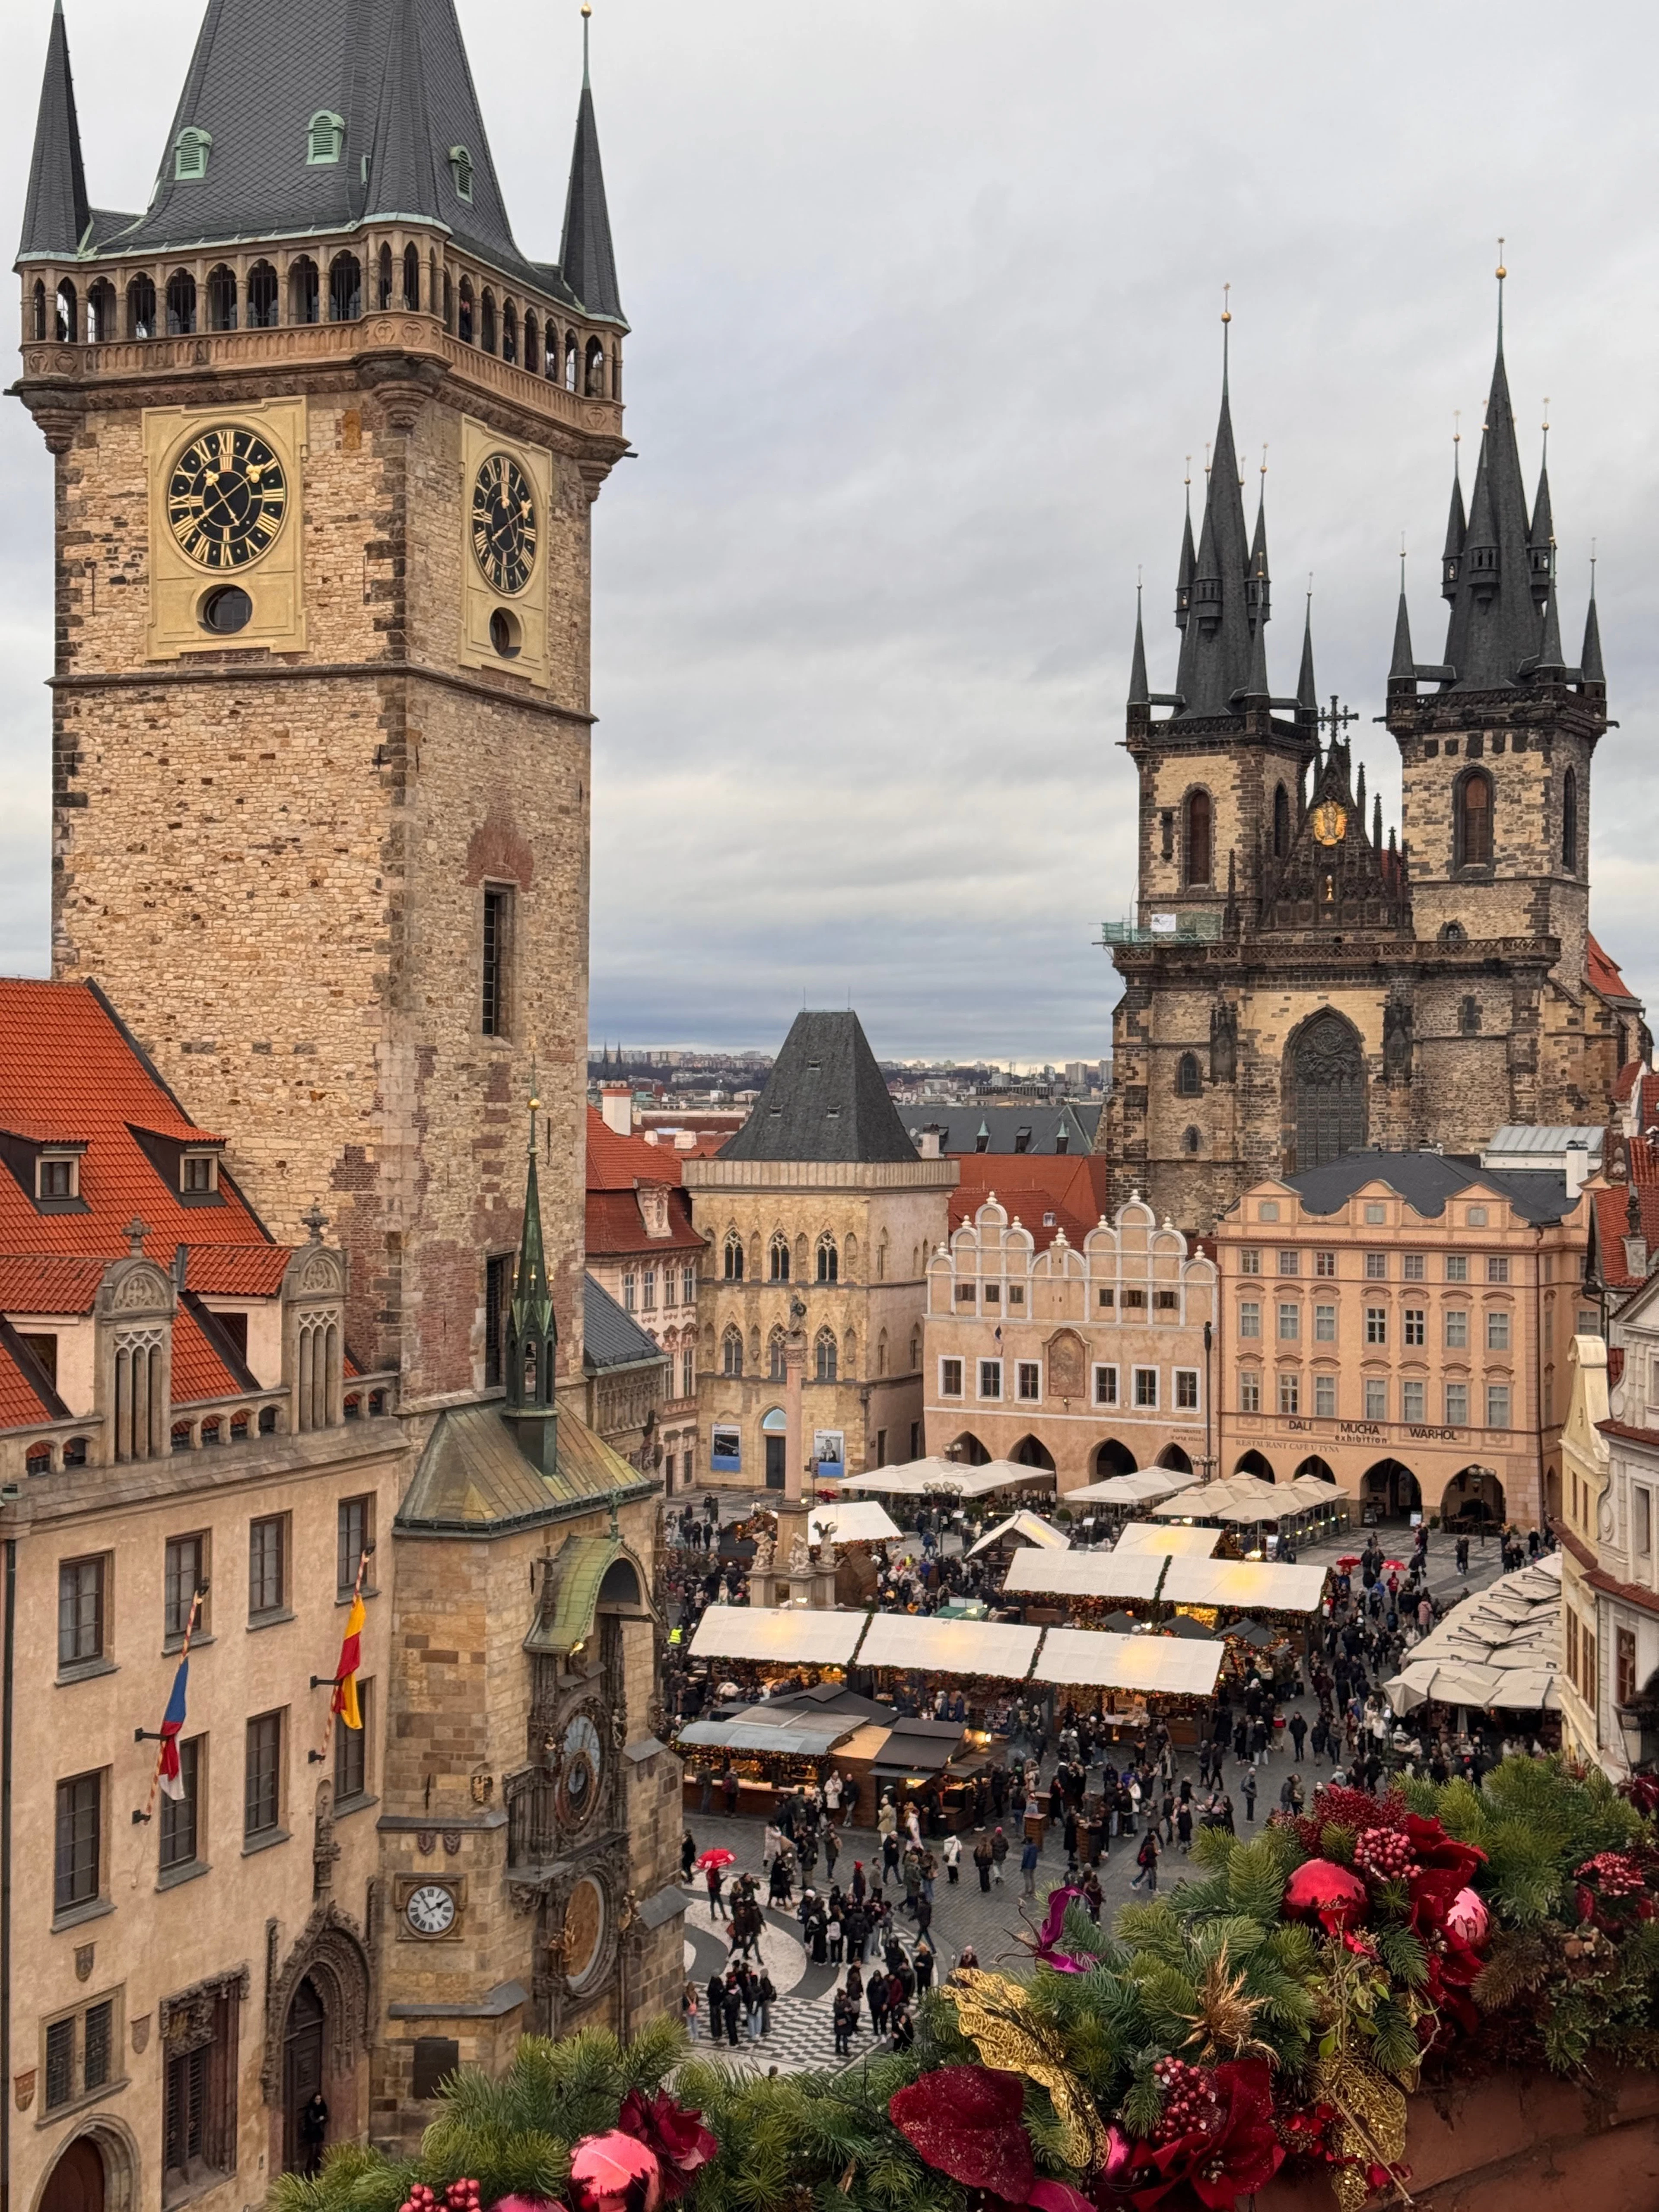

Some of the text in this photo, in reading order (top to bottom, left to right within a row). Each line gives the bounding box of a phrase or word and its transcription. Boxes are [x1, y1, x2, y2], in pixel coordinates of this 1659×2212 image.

[1340, 1423, 1379, 1435] MUCHA
[1409, 1427, 1457, 1440] WARHOL
[1235, 1439, 1287, 1449] RESTAURANT
[1335, 1433, 1387, 1444] exhibition
